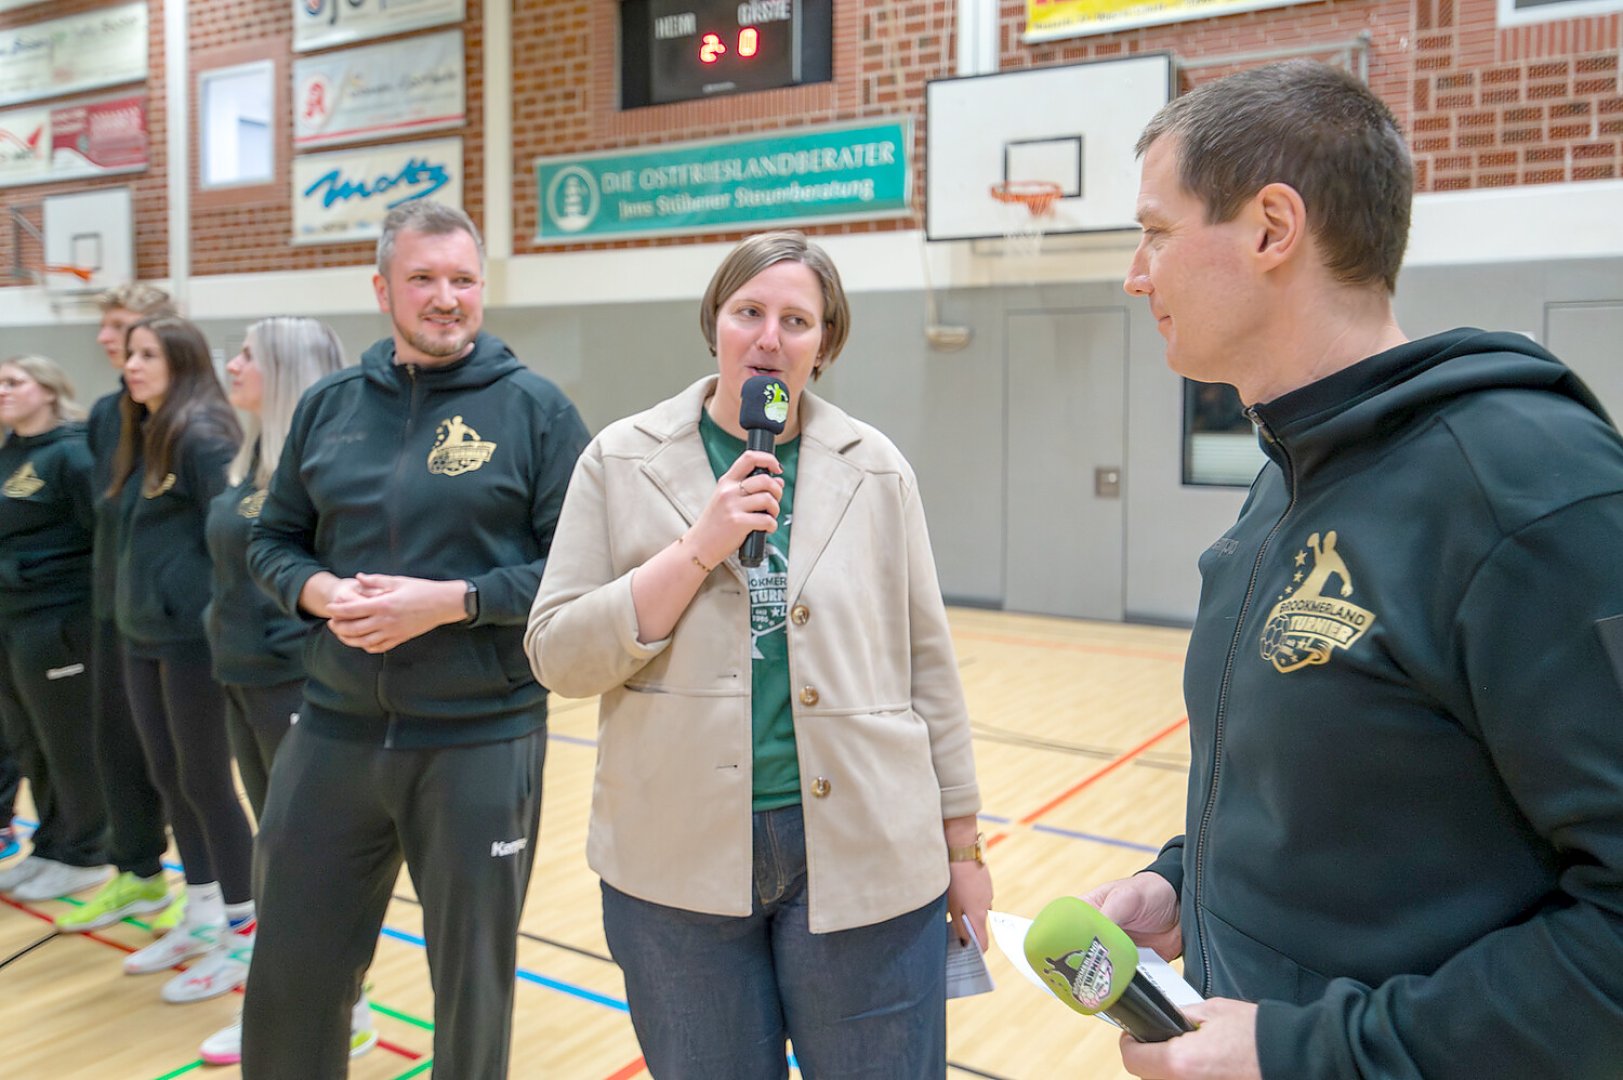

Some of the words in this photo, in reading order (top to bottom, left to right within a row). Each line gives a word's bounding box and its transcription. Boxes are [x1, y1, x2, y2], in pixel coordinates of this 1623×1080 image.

[737, 27, 760, 58] 0
[602, 170, 634, 193] DIE
[638, 140, 896, 190] OSTFRIESLANDBERATER
[734, 177, 874, 210] Steuerberatung
[1278, 599, 1366, 627] BROOKMERLAND
[1289, 614, 1354, 642] TURNIER
